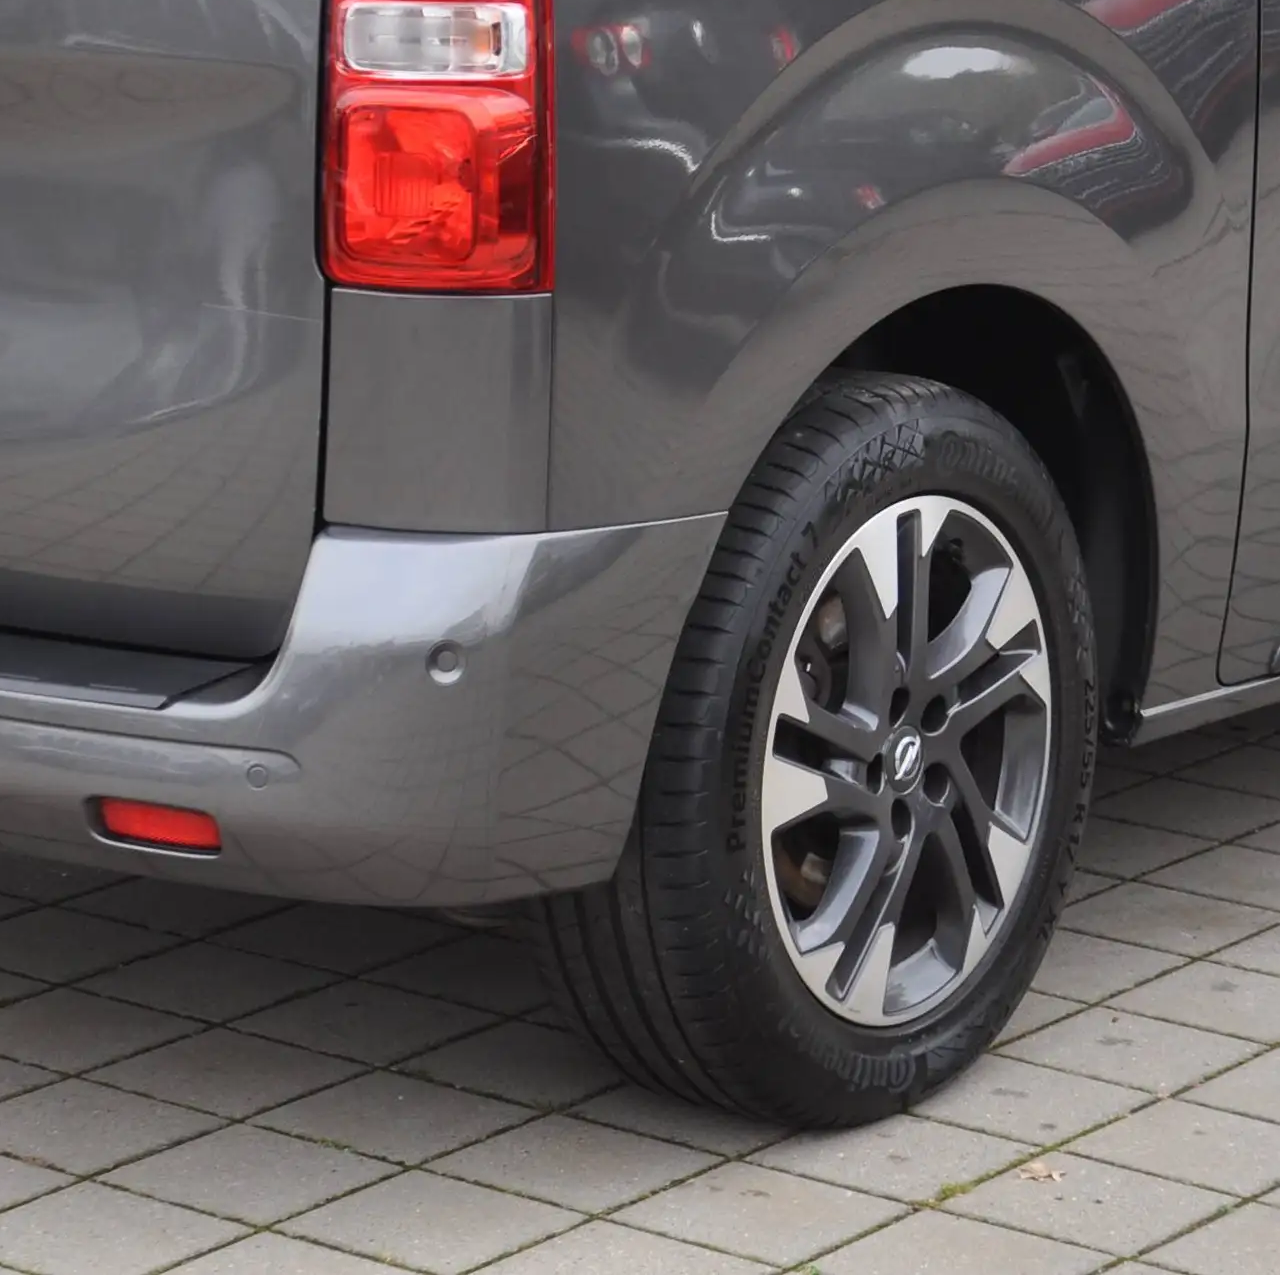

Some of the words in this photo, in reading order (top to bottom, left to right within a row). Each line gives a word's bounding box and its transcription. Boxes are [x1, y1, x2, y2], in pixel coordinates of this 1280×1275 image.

[724, 550, 807, 853] PremiumContact
[800, 520, 820, 550] 7
[1079, 676, 1098, 790] 225/55
